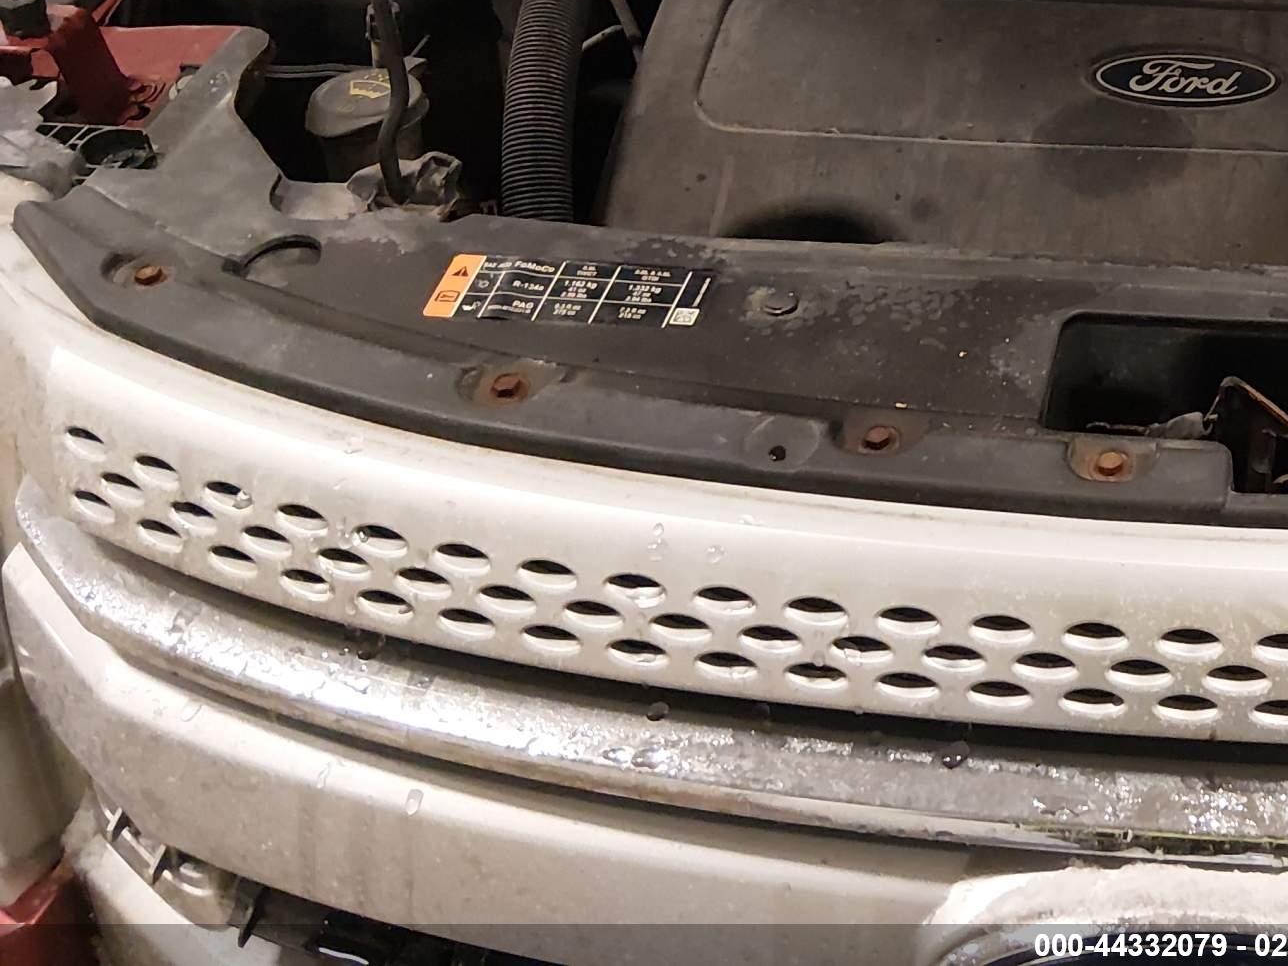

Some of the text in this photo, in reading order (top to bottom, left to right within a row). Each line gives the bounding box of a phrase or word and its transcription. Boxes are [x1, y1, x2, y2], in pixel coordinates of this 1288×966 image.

[1129, 59, 1242, 95] Ford
[514, 260, 555, 273] FoMoCo
[512, 280, 545, 291] R-134a
[650, 285, 662, 294] kg
[512, 300, 534, 309] PAG
